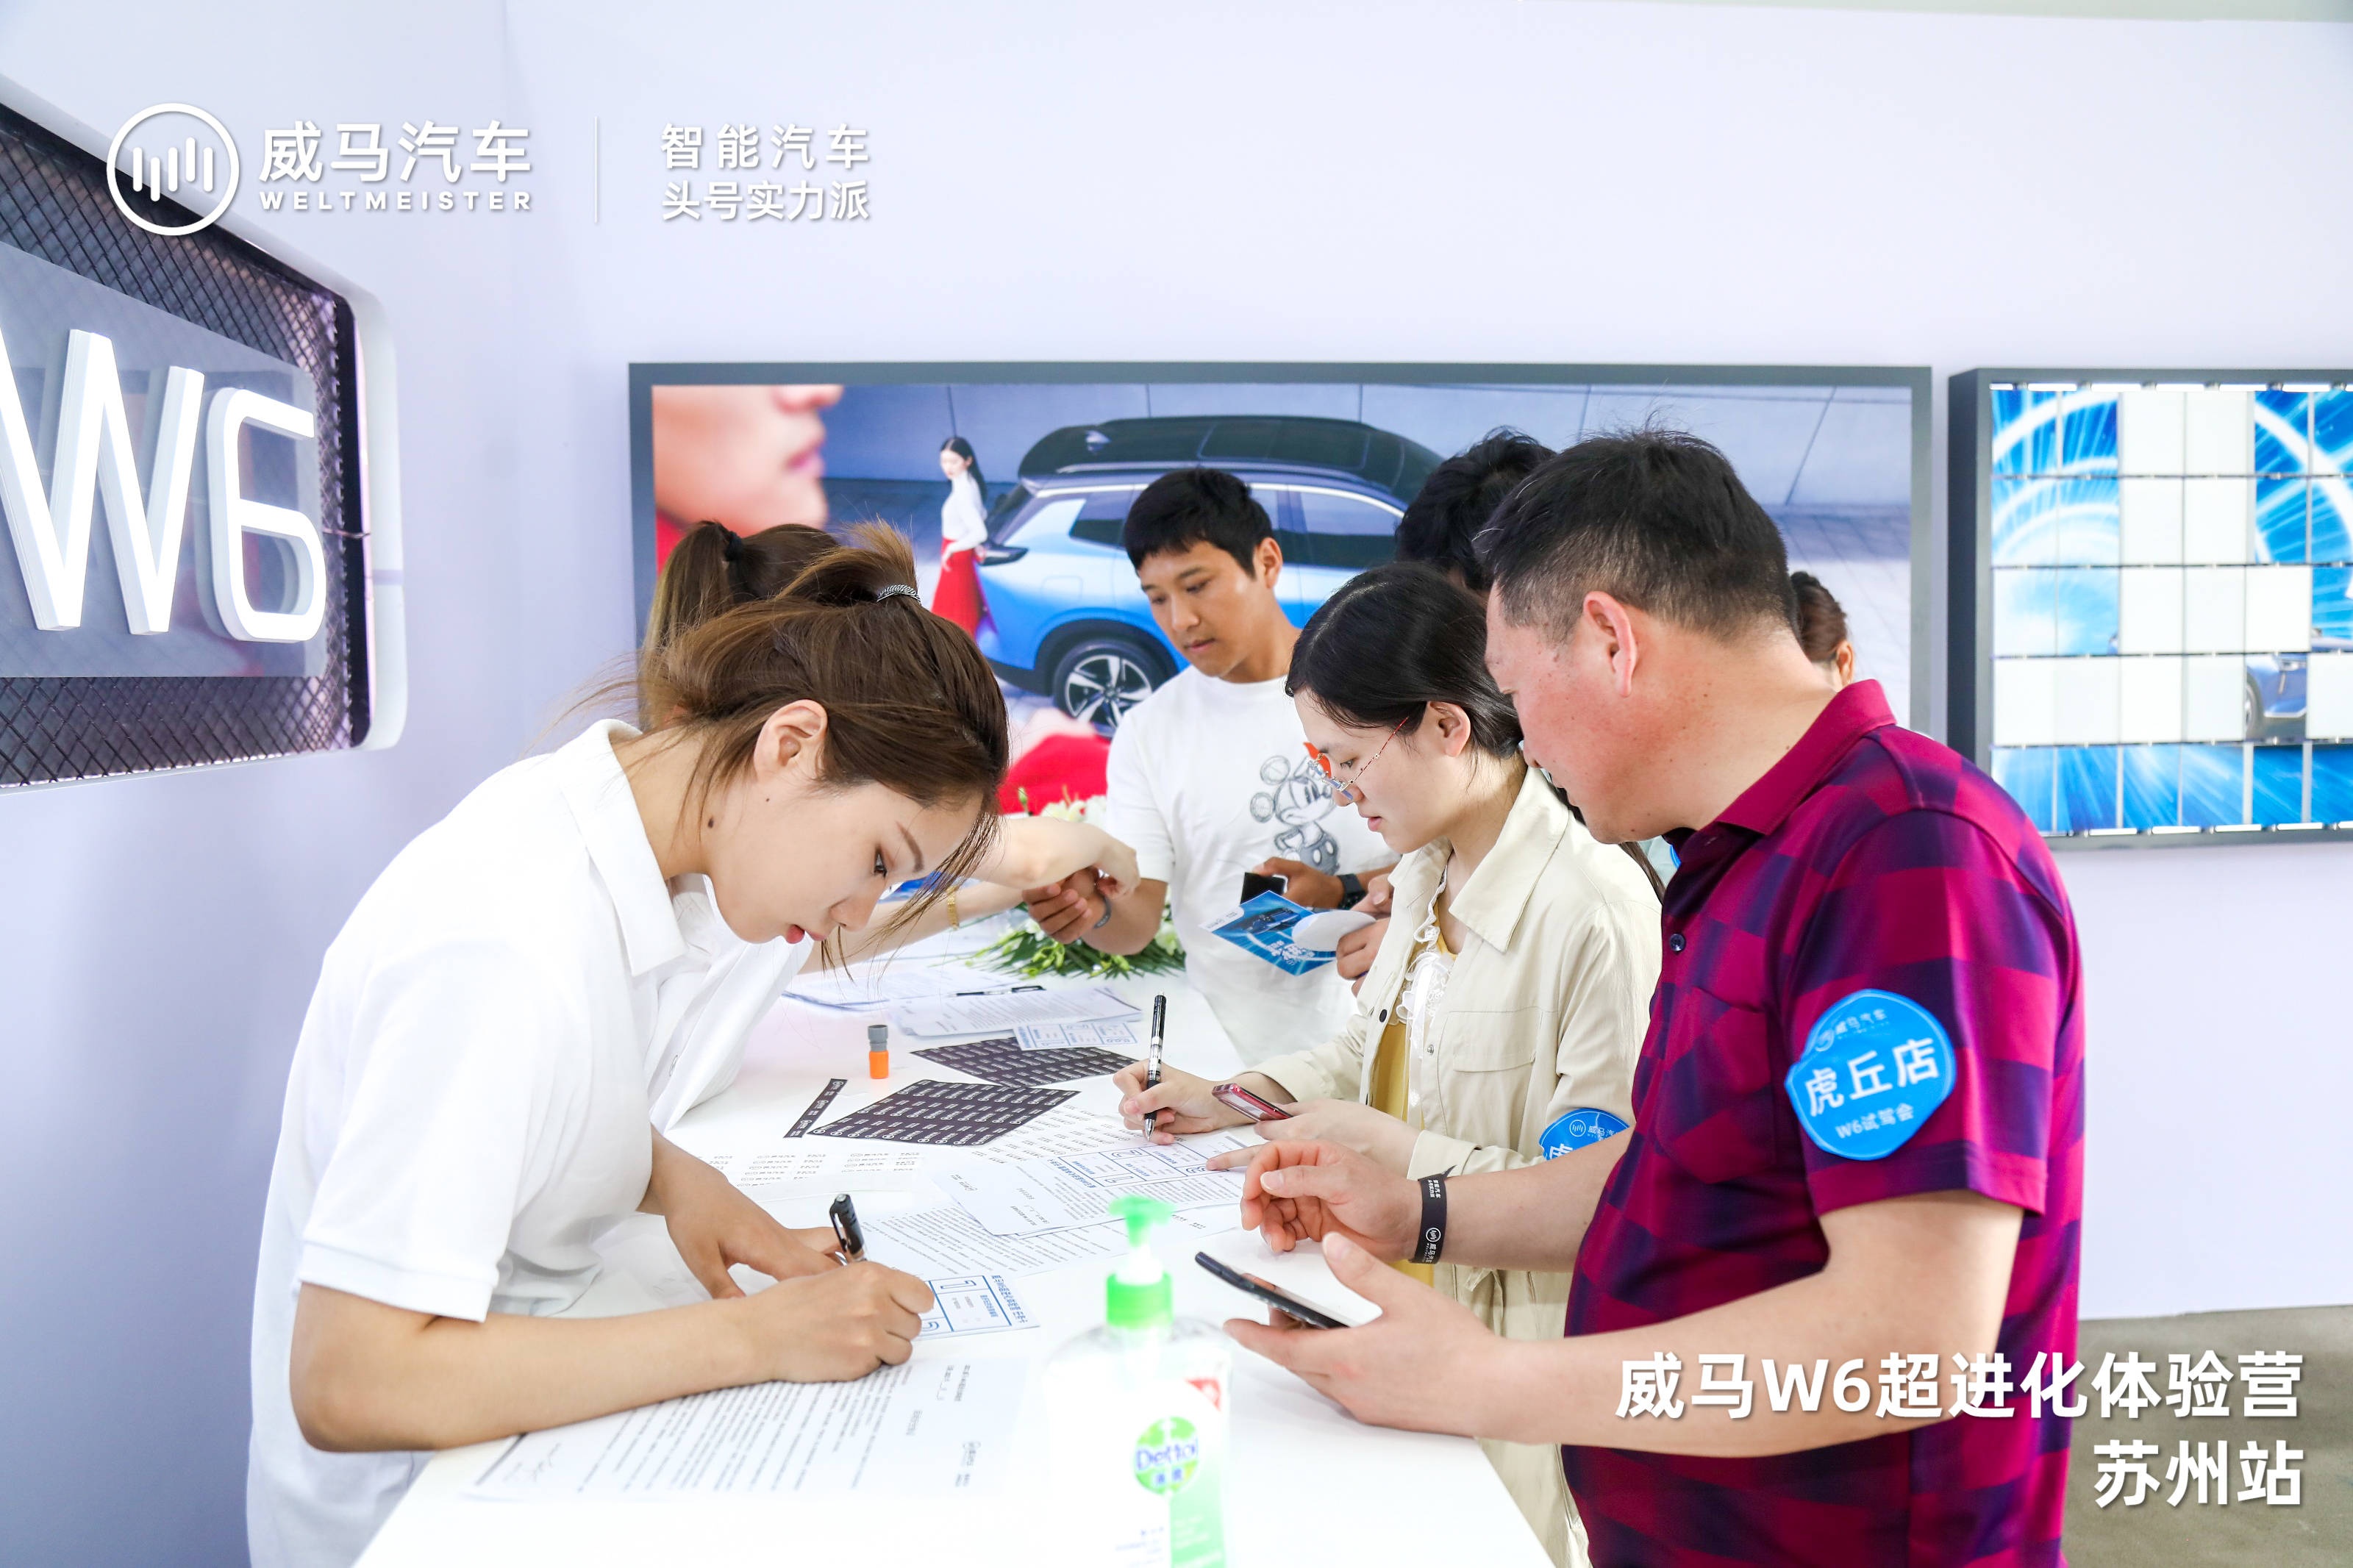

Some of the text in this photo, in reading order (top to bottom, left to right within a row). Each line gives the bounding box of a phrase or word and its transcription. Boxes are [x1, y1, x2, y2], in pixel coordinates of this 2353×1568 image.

[0, 329, 327, 643] W6
[1804, 1037, 1940, 1117] 虎丘店
[1588, 1125, 1618, 1137] 威马汽
[1835, 1102, 1914, 1139] W6试驾会
